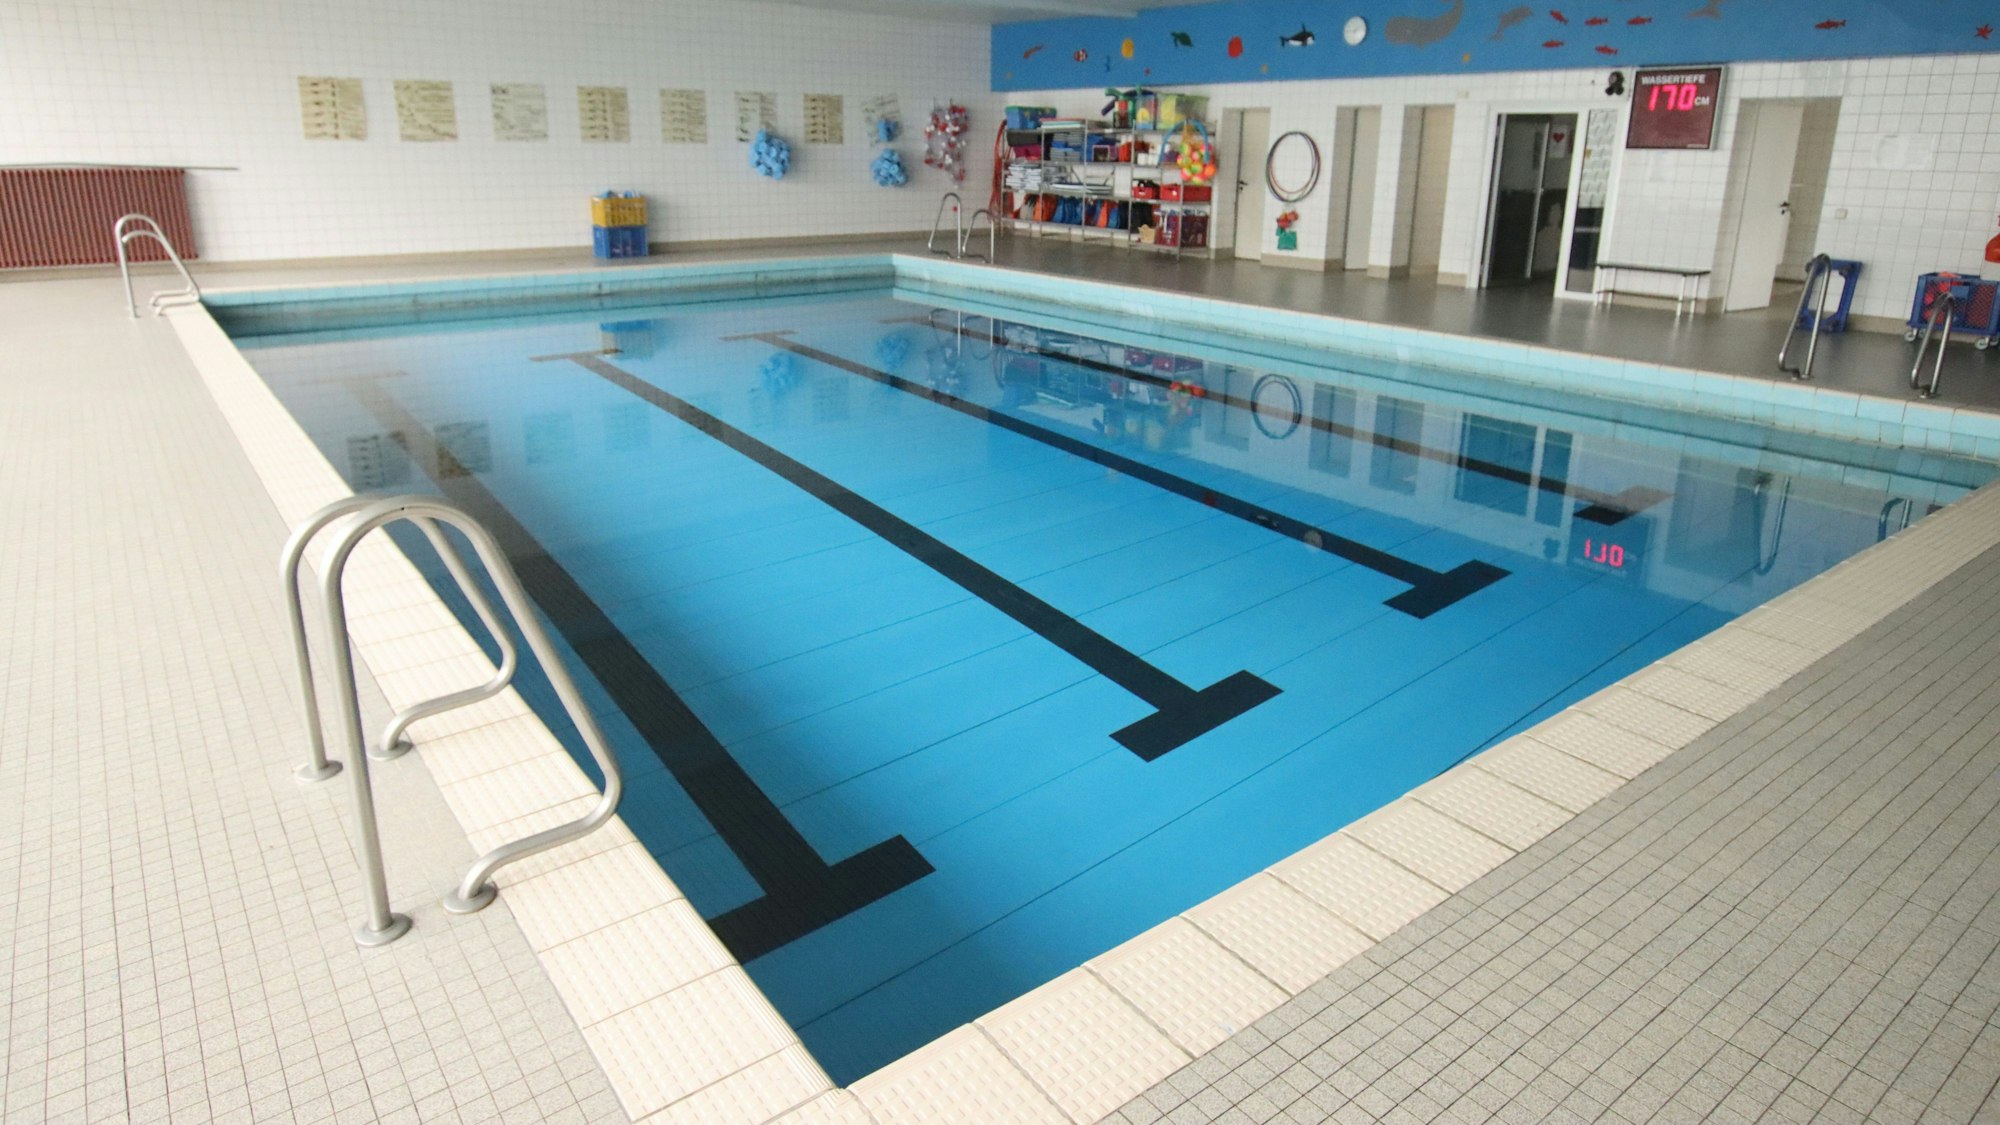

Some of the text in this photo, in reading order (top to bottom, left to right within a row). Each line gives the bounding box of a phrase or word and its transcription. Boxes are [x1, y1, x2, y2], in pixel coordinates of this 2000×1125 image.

[1641, 74, 1706, 85] WASSERTIEFE
[1648, 83, 1710, 112] 170 CM
